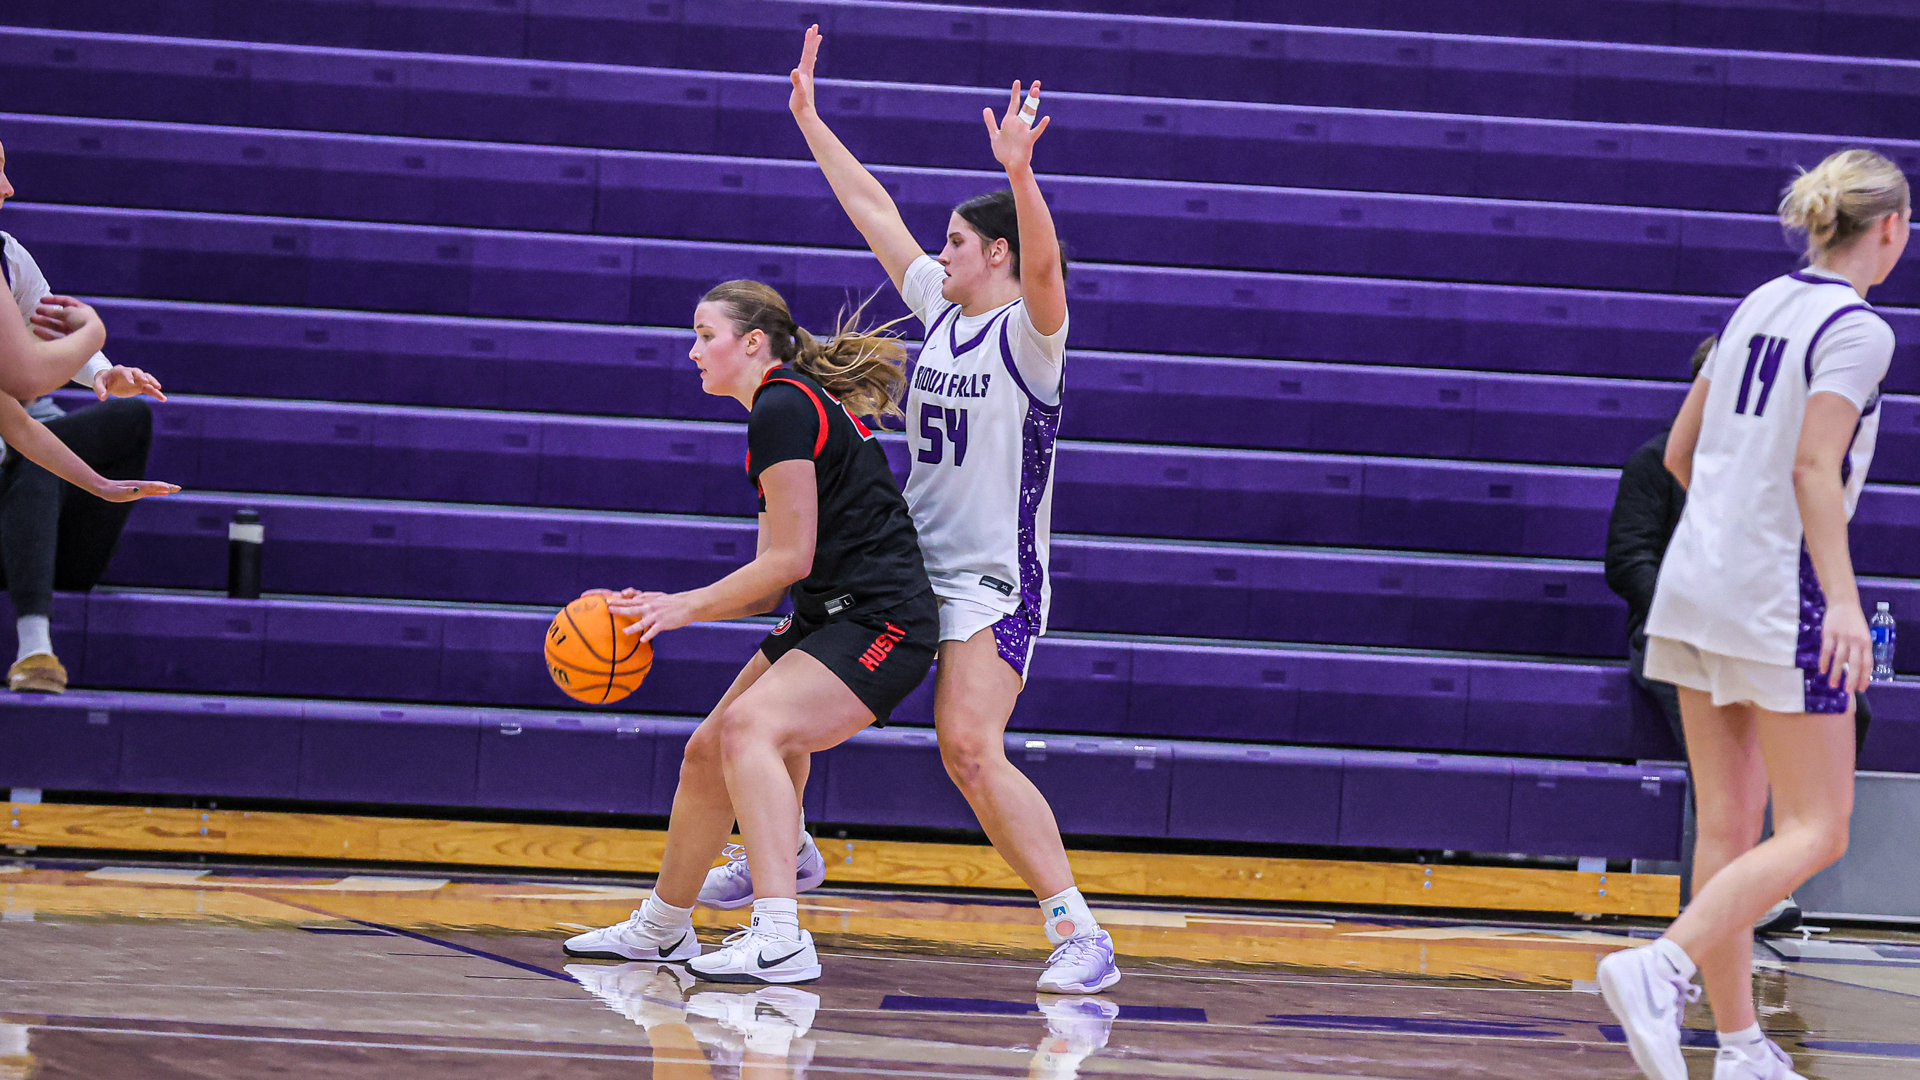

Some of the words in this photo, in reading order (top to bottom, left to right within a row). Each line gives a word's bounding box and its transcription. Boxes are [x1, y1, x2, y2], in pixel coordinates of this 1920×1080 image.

[914, 365, 949, 396] SIOUX
[946, 373, 991, 398] FALLS
[1734, 332, 1790, 418] 14
[917, 402, 968, 467] 54
